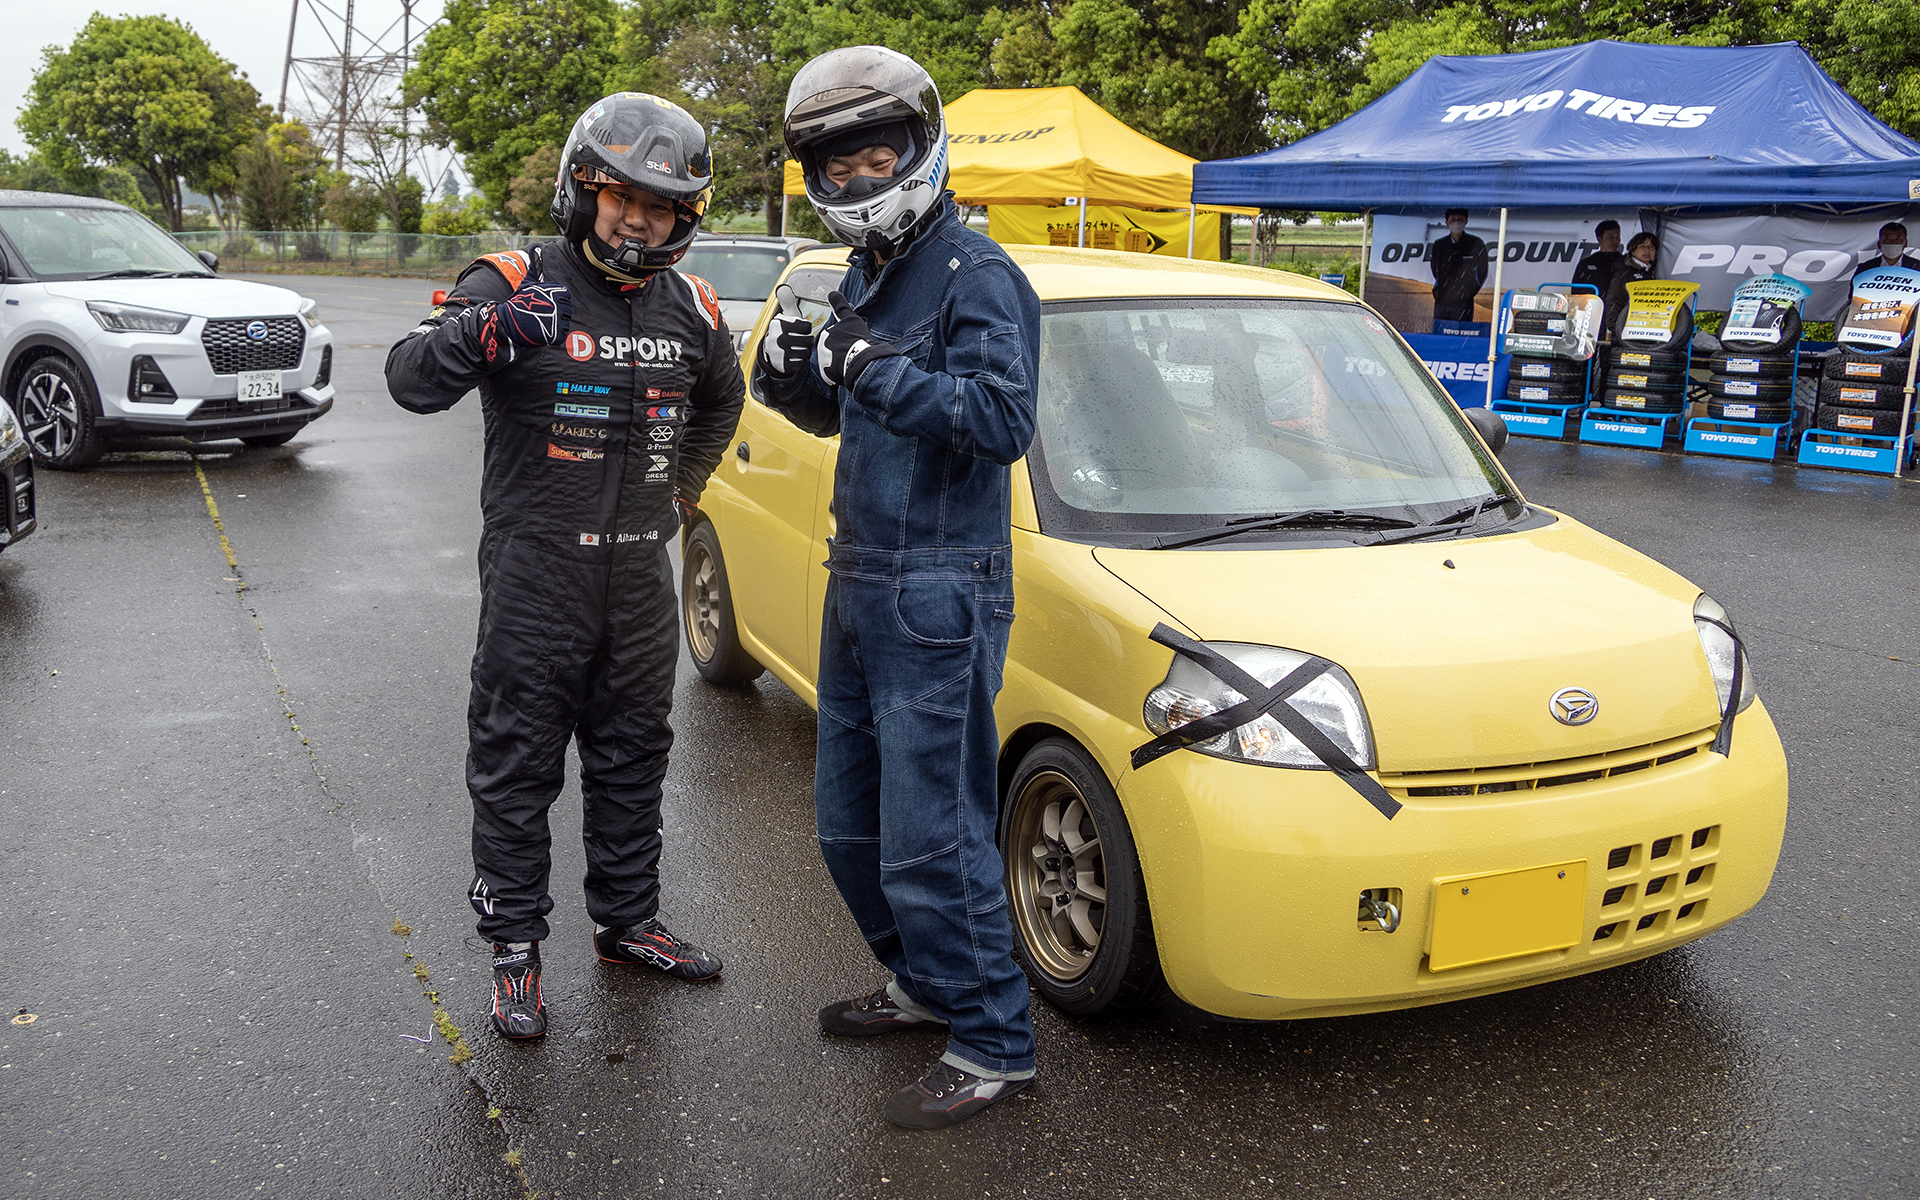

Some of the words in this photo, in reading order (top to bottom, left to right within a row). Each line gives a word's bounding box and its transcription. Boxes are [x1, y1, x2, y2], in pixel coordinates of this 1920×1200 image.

[1439, 89, 1564, 123] TOYO
[1564, 88, 1717, 128] TIRES
[947, 126, 1056, 144] UNLOP
[646, 160, 672, 174] Stilo
[1381, 242, 1434, 263] OPE
[1487, 241, 1625, 263] COUNT
[1874, 275, 1913, 284] OPEN
[1858, 283, 1920, 293] COUNTRY
[1868, 332, 1893, 341] TIRES
[599, 335, 682, 361] SPORT
[1344, 355, 1387, 378] TOY
[248, 382, 279, 398] 22-34
[570, 384, 594, 393] HALF
[594, 386, 611, 394] WAY
[1500, 413, 1524, 422] TOYO
[1524, 415, 1549, 424] TIRES
[563, 426, 598, 438] ARIES
[1594, 422, 1620, 431] TOYO
[1620, 424, 1648, 434] TIRES
[1700, 433, 1728, 442] TOYO
[1728, 435, 1758, 445] TIRES
[550, 446, 575, 457] Super
[576, 449, 604, 460] yellow
[1815, 445, 1844, 455] TOYO
[1844, 447, 1878, 458] TIRES
